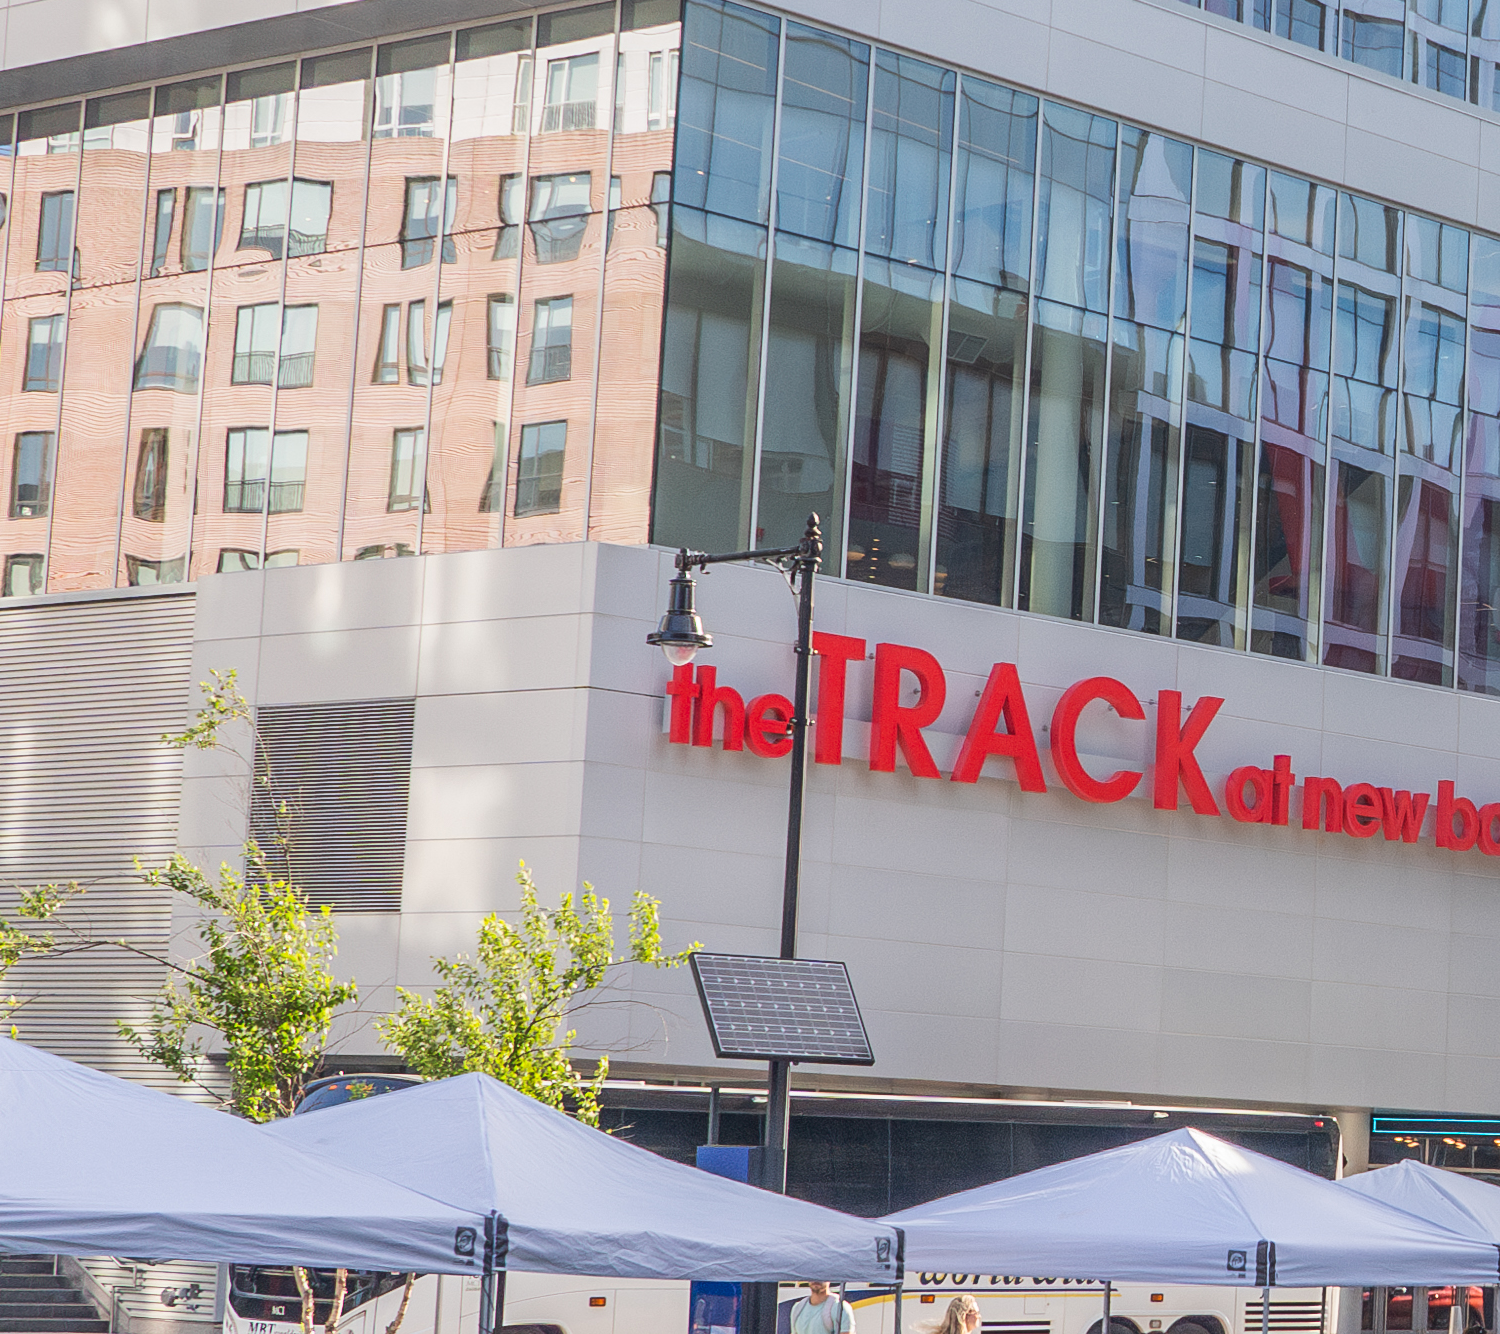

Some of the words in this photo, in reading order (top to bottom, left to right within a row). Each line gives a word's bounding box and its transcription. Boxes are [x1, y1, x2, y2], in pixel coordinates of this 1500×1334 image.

[666, 663, 796, 760] the
[812, 631, 1225, 816] TRACK
[1225, 755, 1293, 826] at
[1302, 776, 1430, 844] new
